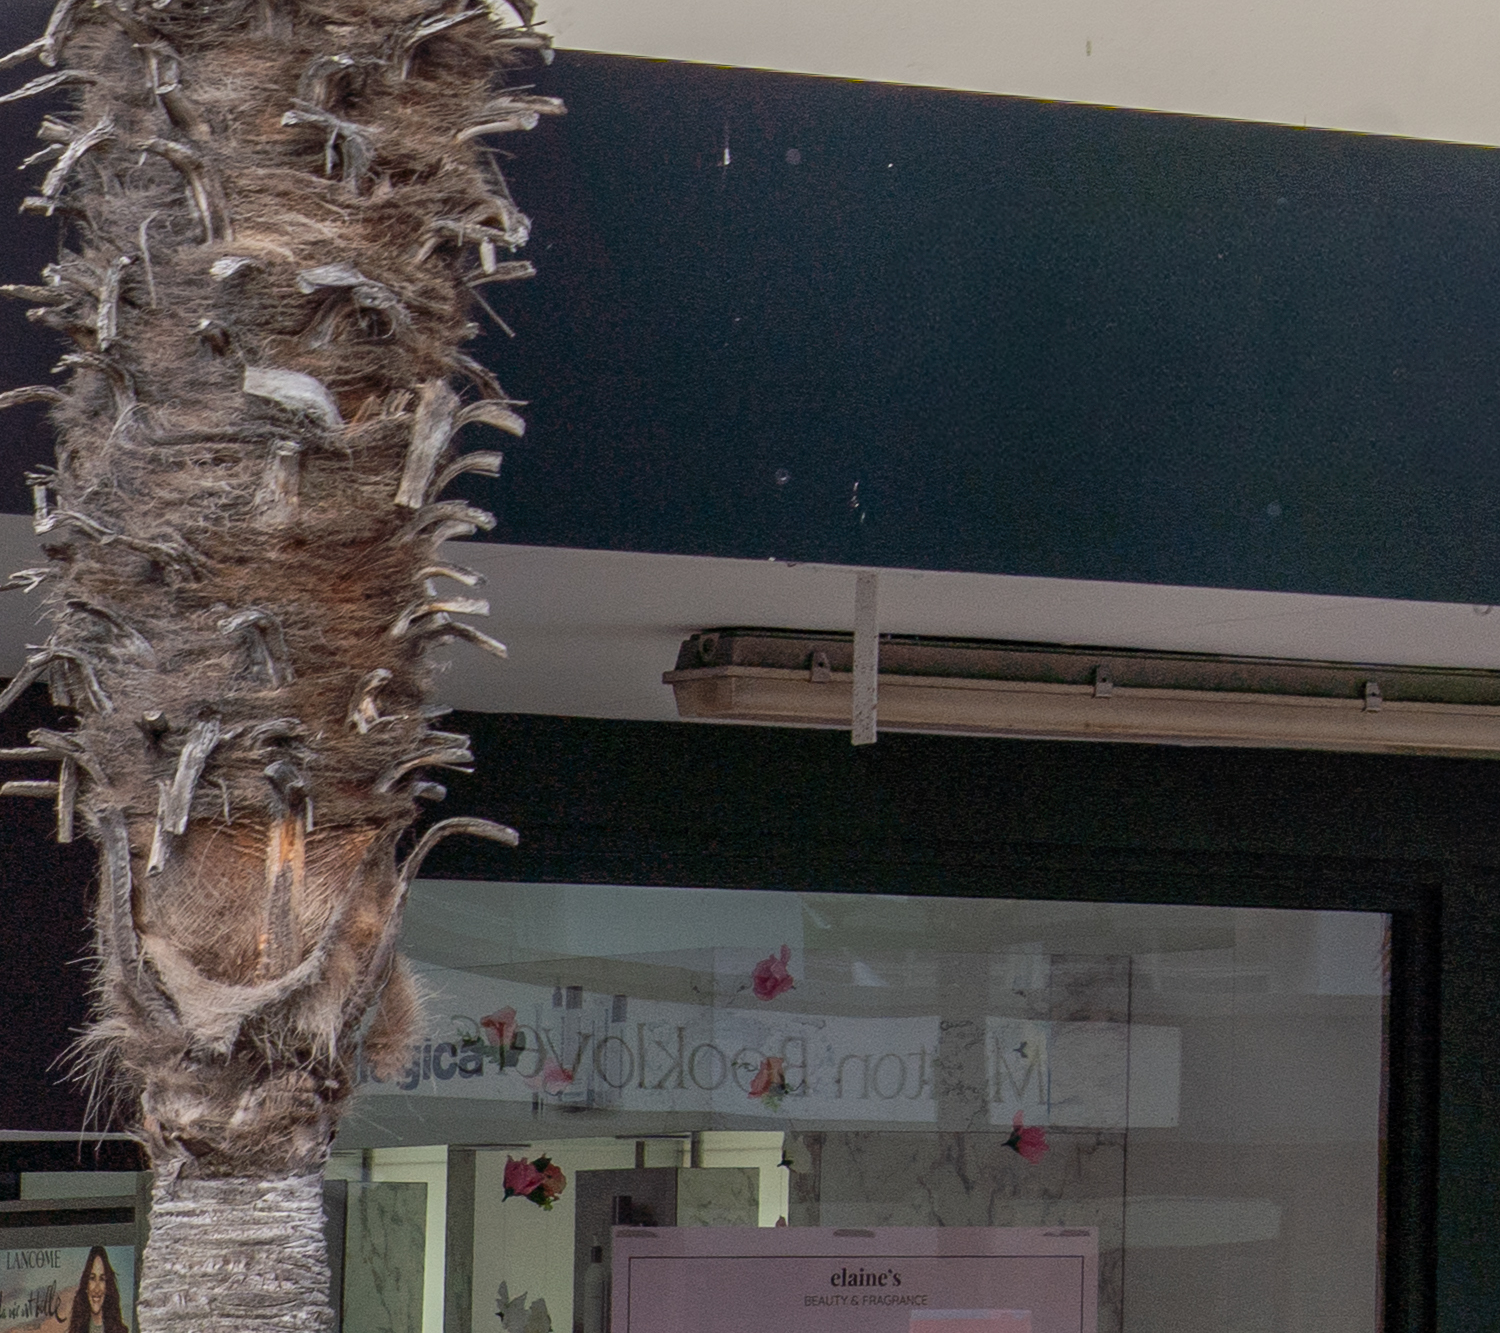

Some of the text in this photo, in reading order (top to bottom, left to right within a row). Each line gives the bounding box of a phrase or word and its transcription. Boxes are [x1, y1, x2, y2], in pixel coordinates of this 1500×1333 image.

[830, 1267, 902, 1287] elaine's
[804, 1294, 928, 1307] BEAUTY & FRAGRANCE
